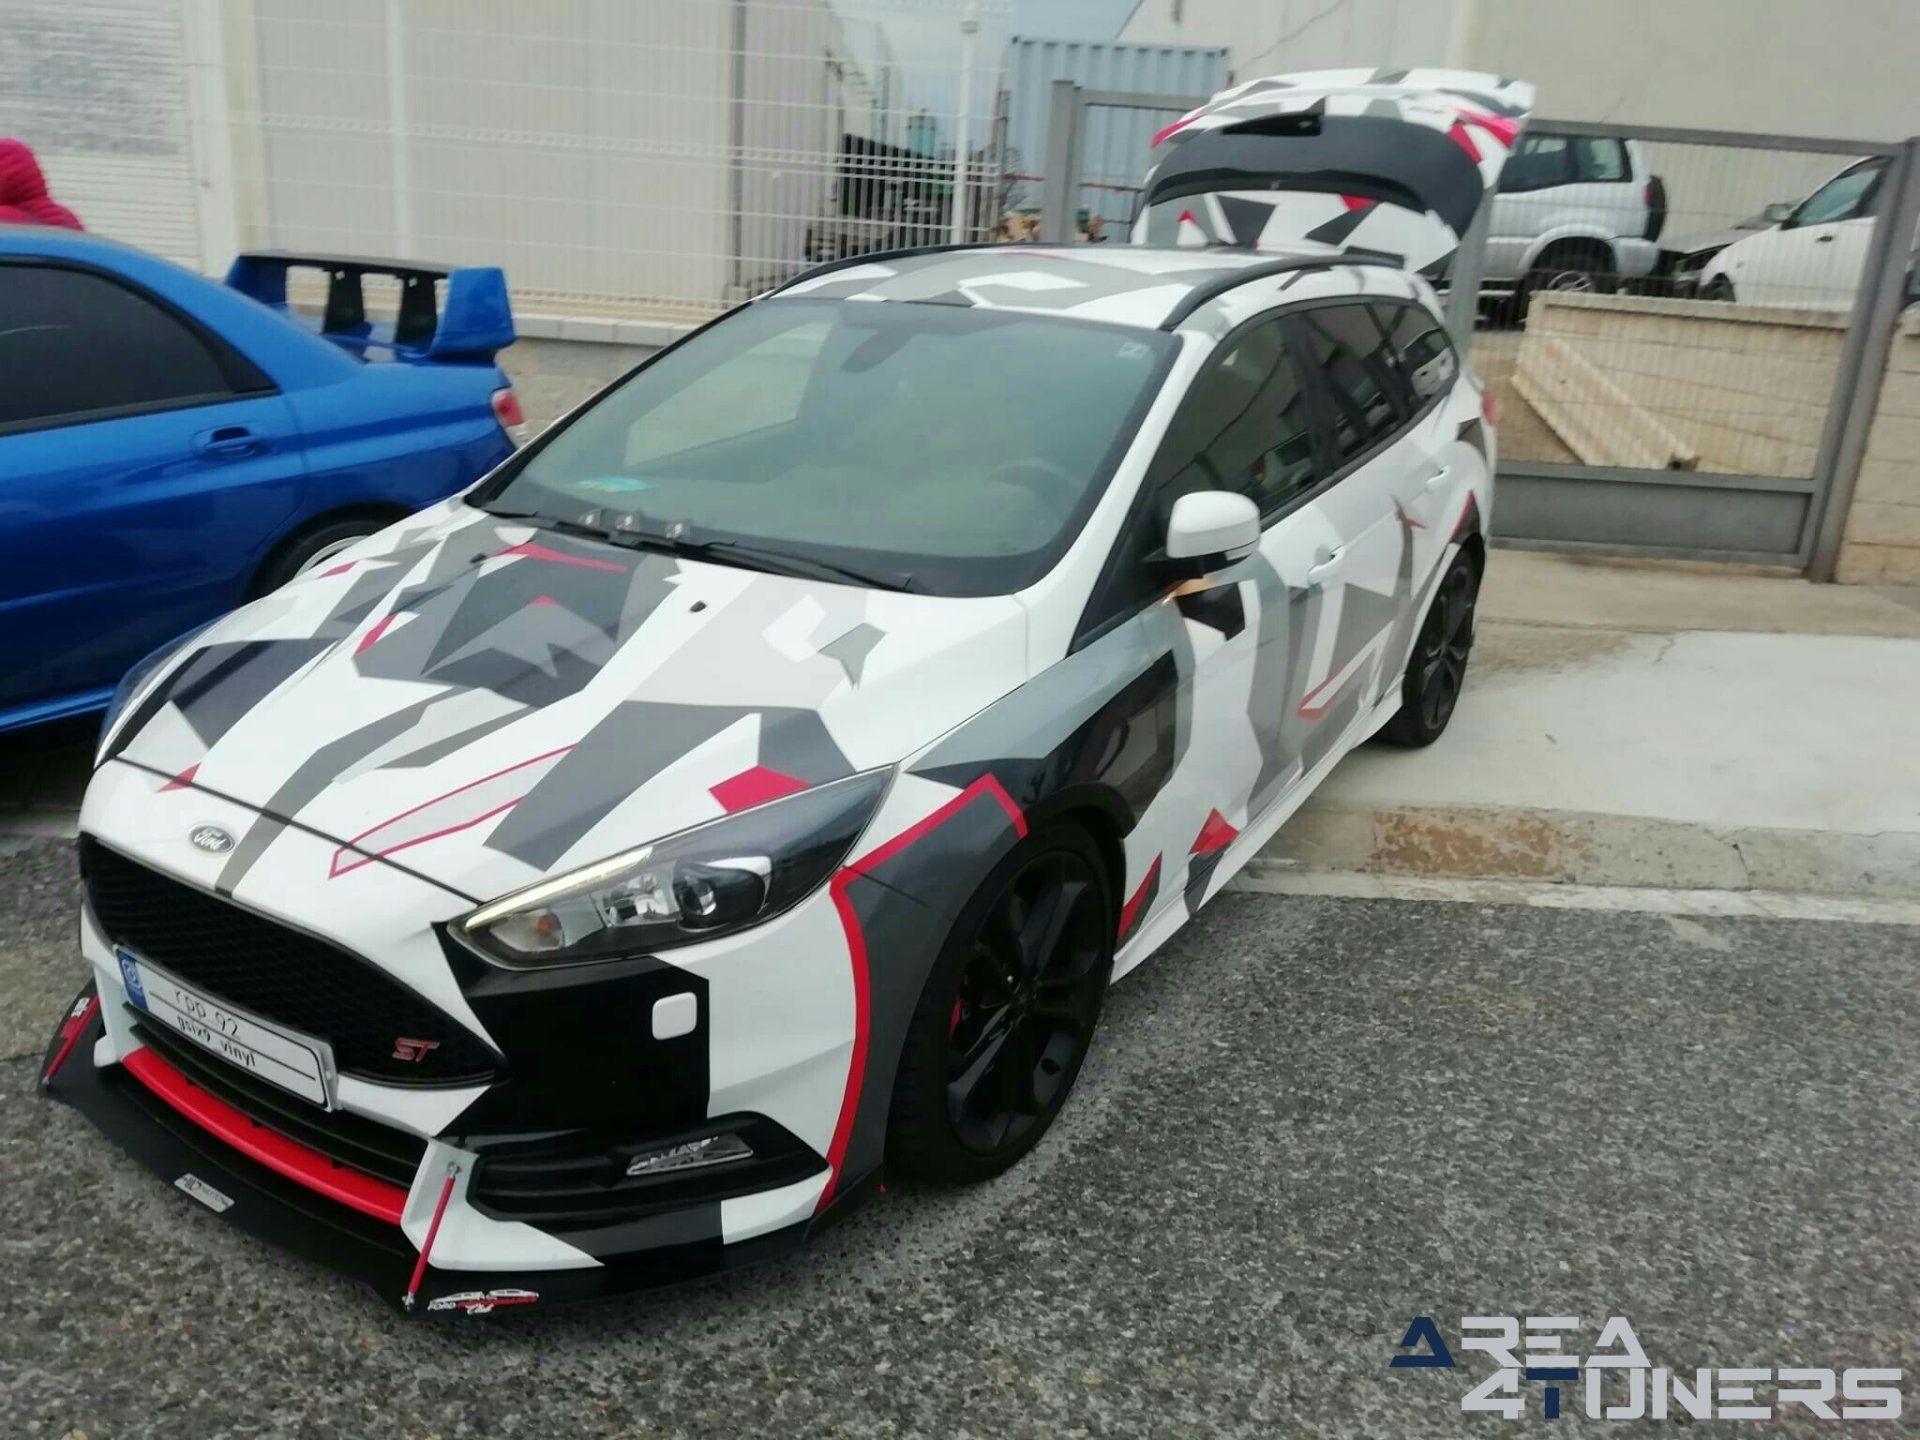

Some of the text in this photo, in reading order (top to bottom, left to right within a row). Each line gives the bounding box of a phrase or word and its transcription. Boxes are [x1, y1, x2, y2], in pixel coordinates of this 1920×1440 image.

[193, 829, 228, 851] Ford
[215, 1011, 241, 1040] 92
[220, 1040, 256, 1067] vinyl
[391, 1037, 440, 1062] ST
